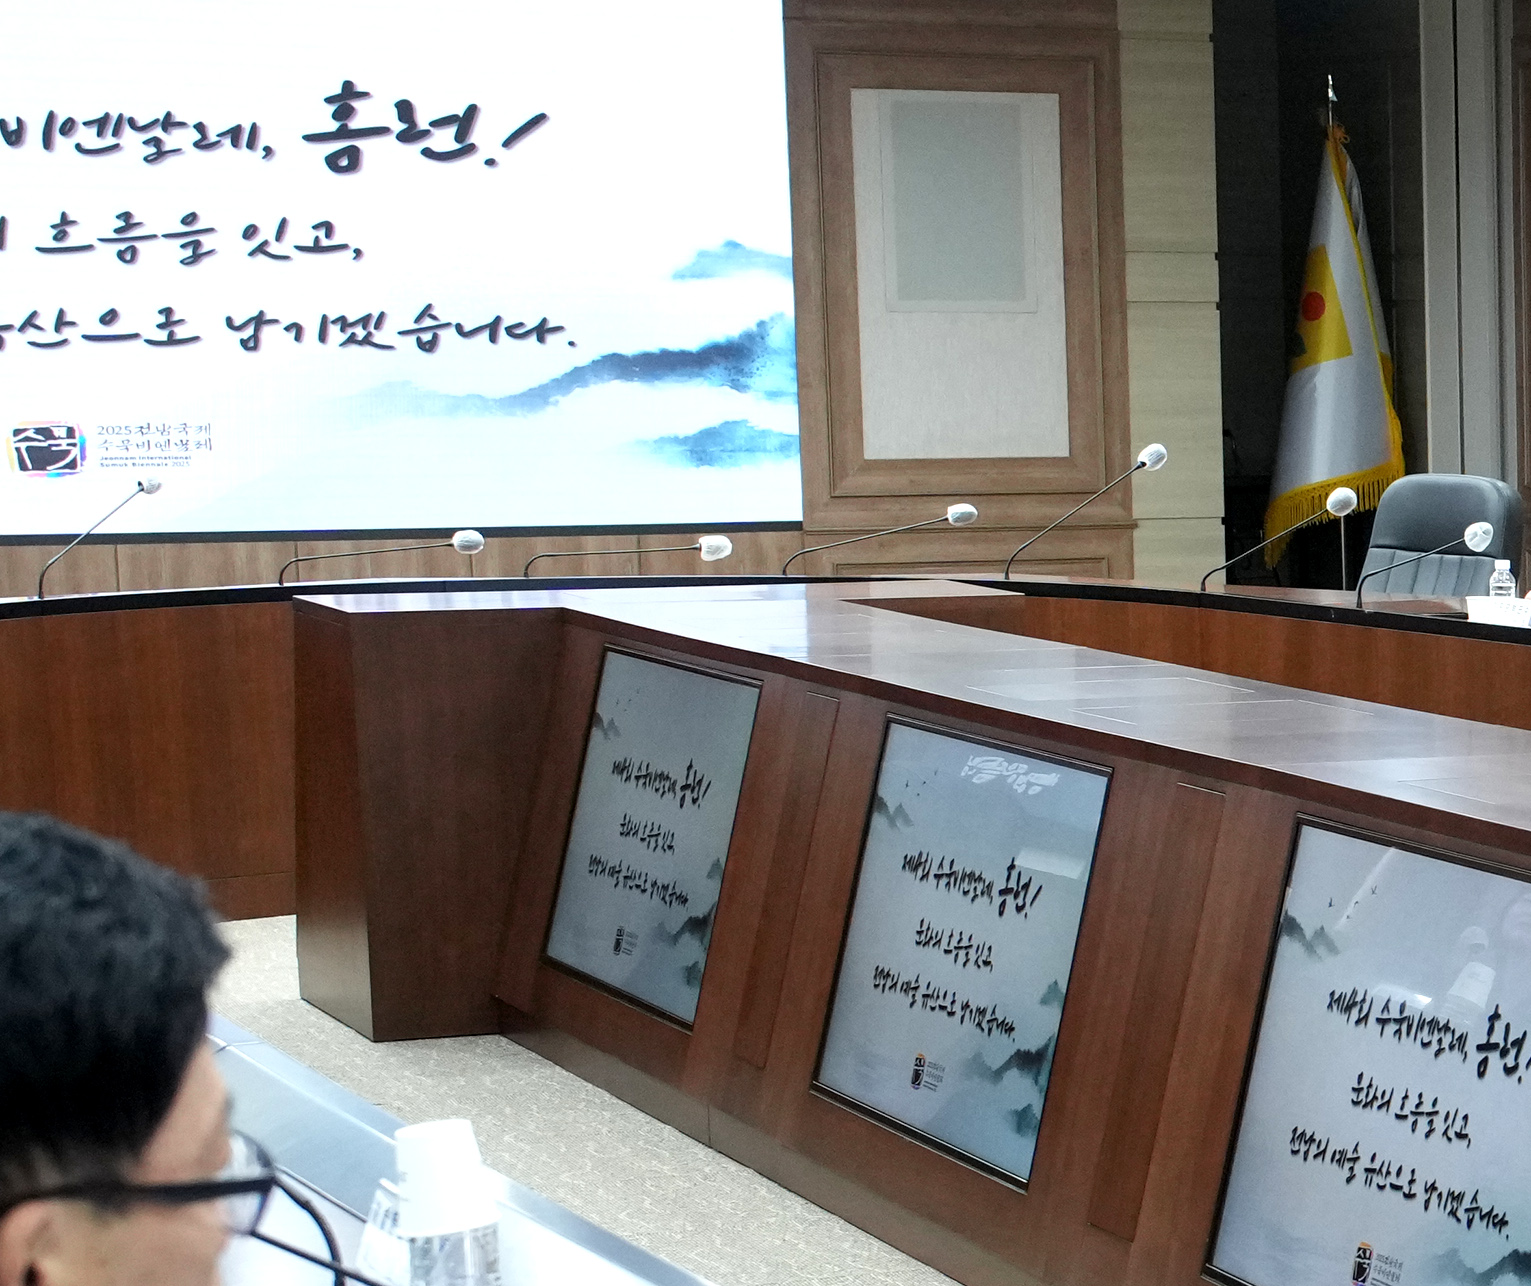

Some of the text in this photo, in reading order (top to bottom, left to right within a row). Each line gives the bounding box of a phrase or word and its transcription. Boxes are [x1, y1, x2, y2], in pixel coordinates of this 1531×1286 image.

[34, 210, 364, 267] 흐름을 잇고,
[0, 302, 577, 354] 산으로 남기겠습니다.
[914, 916, 944, 950] 문화의
[1326, 986, 1374, 1028] 제4회
[1349, 1070, 1471, 1149] 문화의 흐름을 잇고,
[1288, 1124, 1330, 1163] 전남의
[1329, 1140, 1361, 1185] 예술
[1362, 1151, 1417, 1201] 유산으로
